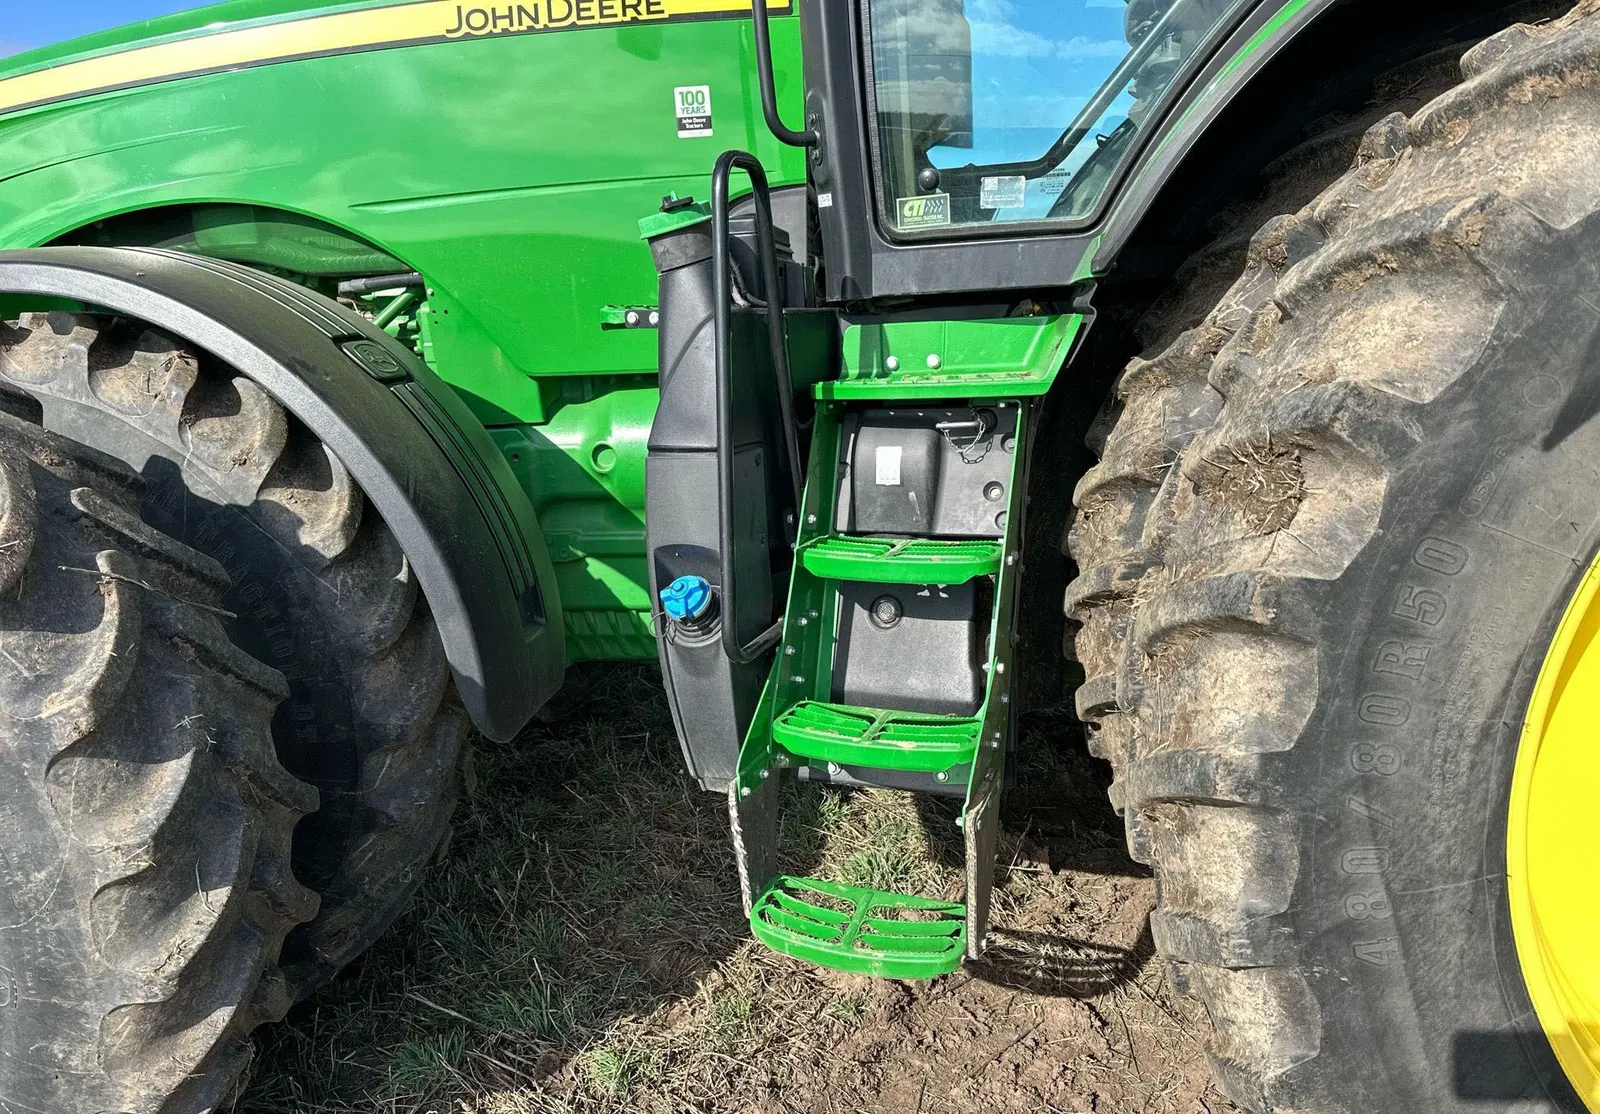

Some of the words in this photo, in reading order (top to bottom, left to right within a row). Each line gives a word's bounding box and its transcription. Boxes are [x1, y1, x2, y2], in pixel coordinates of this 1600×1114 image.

[446, 3, 539, 34] JOHN
[547, 0, 665, 23] DEERE
[678, 90, 705, 106] 100
[680, 106, 706, 114] YEARS
[903, 199, 927, 217] CTI
[1456, 624, 1482, 676] SERVICE
[1341, 535, 1470, 968] 480/80R50
